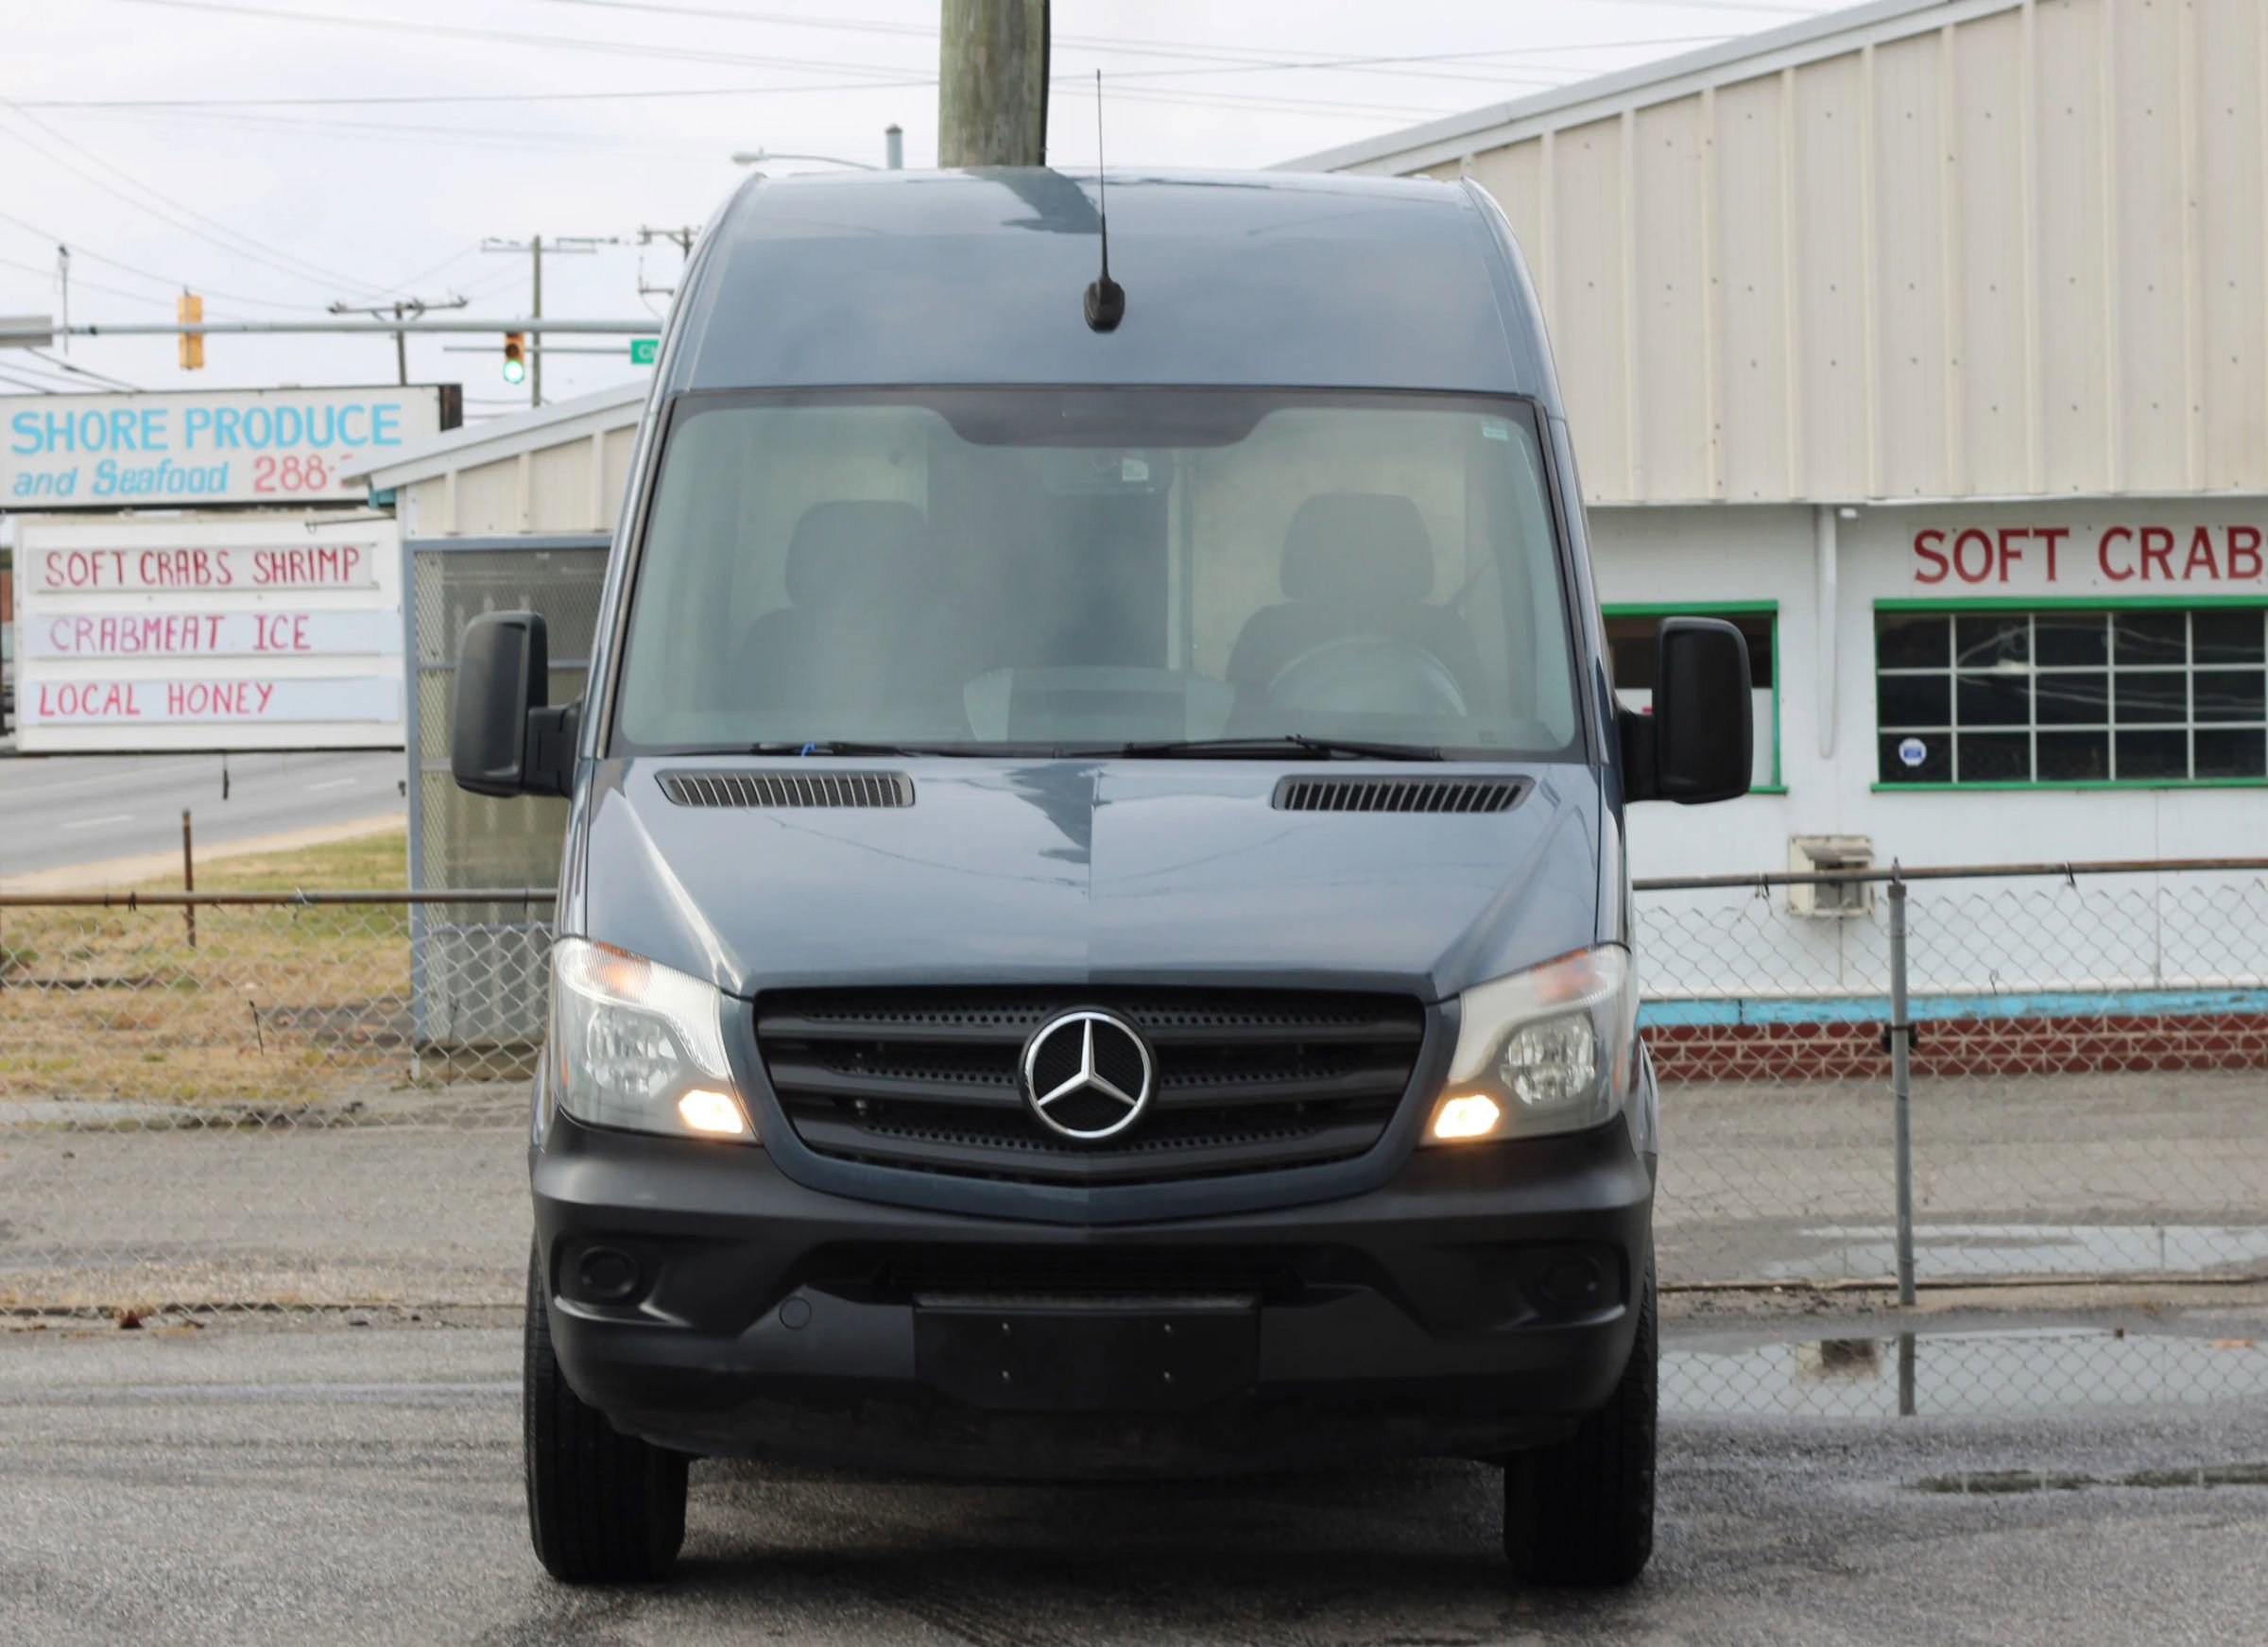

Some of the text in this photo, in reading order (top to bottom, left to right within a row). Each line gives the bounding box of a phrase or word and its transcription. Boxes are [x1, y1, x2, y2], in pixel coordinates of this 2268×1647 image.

[10, 403, 403, 455] SHORE PRODUCE
[12, 468, 78, 497] and
[92, 457, 230, 497] Seafood
[45, 546, 360, 586] SOFT CRABS SHRIMP
[1914, 525, 2268, 584] SOFT CRAB
[50, 614, 311, 652] CRABMEAT ICE
[39, 682, 273, 716] LOCAL HONEY
